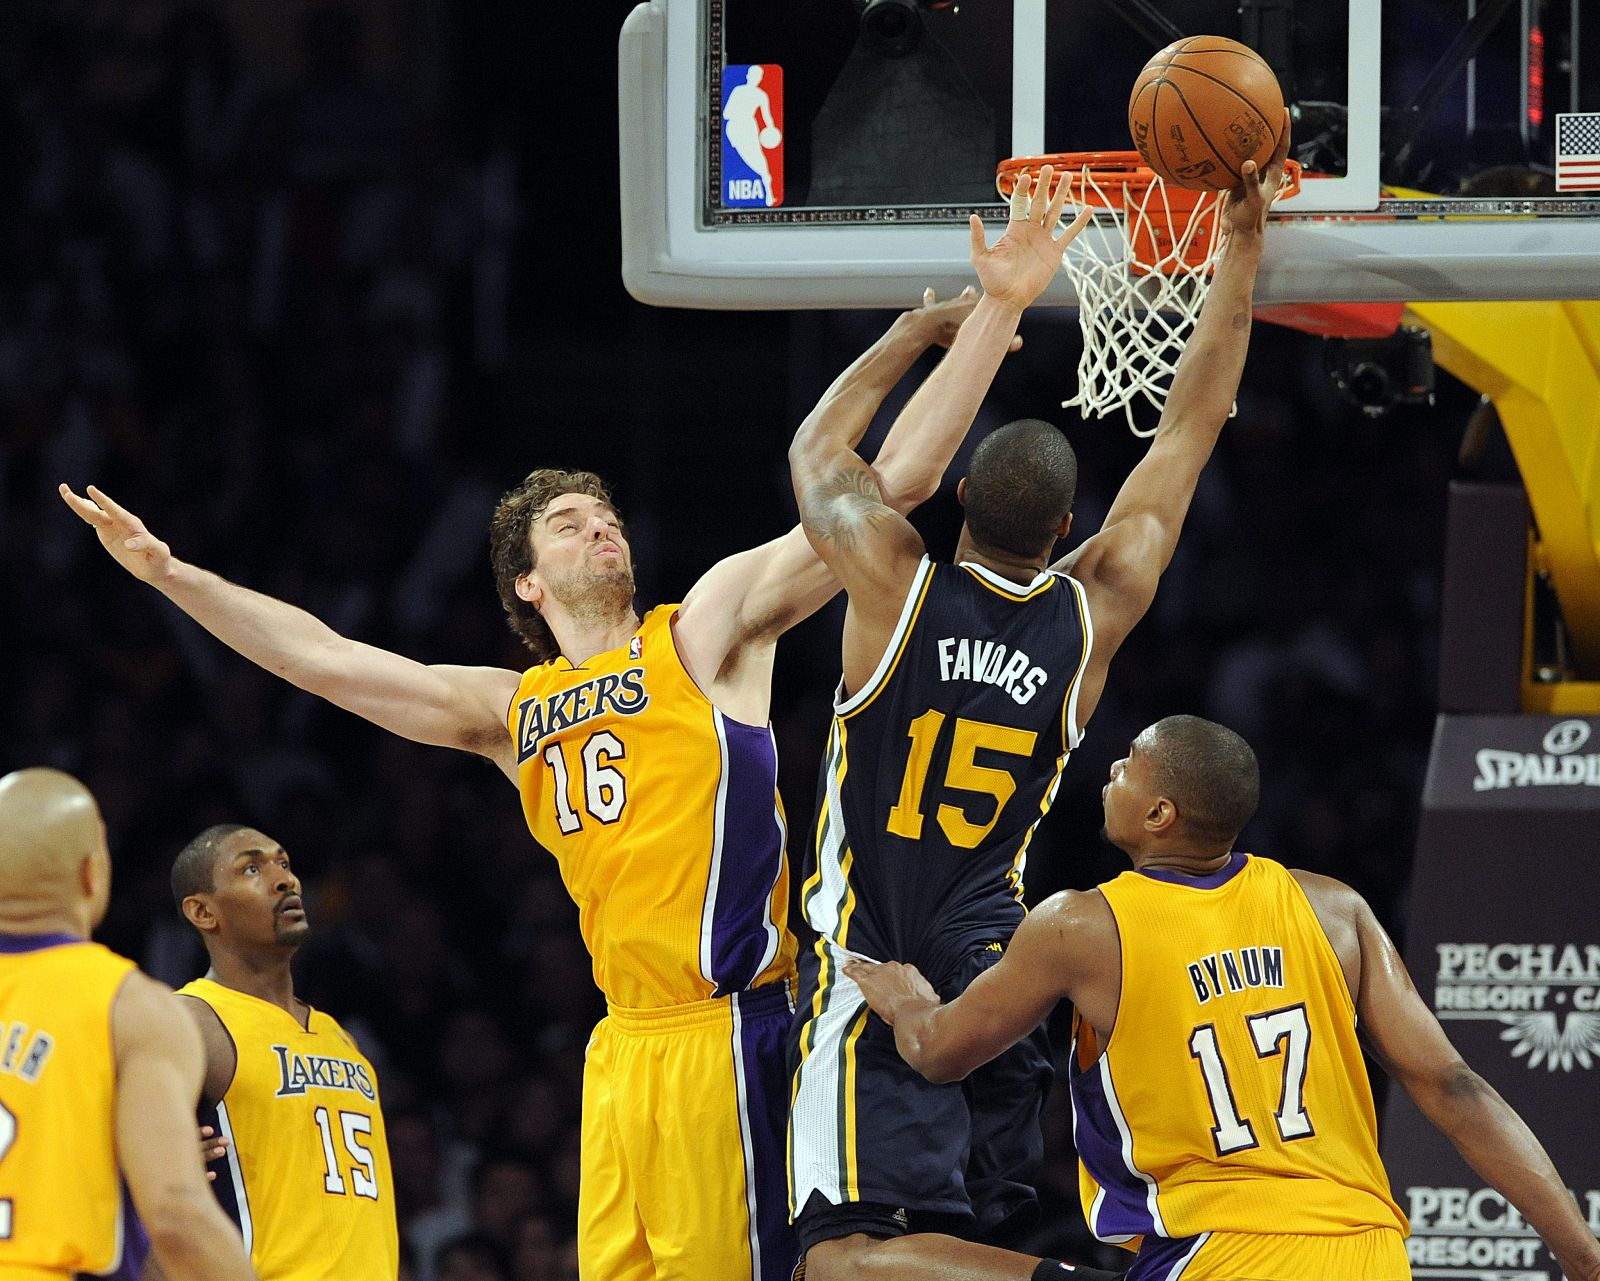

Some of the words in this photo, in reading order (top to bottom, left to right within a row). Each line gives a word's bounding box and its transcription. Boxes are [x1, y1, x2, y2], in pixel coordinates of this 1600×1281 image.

[728, 179, 765, 200] NBA
[938, 637, 1048, 705] FAVORS
[517, 667, 649, 766] LAKERS
[543, 729, 627, 836] 16
[886, 708, 1038, 850] 15
[1473, 747, 1600, 792] SPALDI
[1186, 946, 1284, 1005] BYNUM
[1435, 985, 1549, 1011] RESORT
[0, 1020, 55, 1083] ER
[272, 1044, 376, 1102] LAKERS
[1188, 1001, 1315, 1157] 17
[313, 1106, 379, 1201] 15
[1405, 1237, 1542, 1268] RESORT
